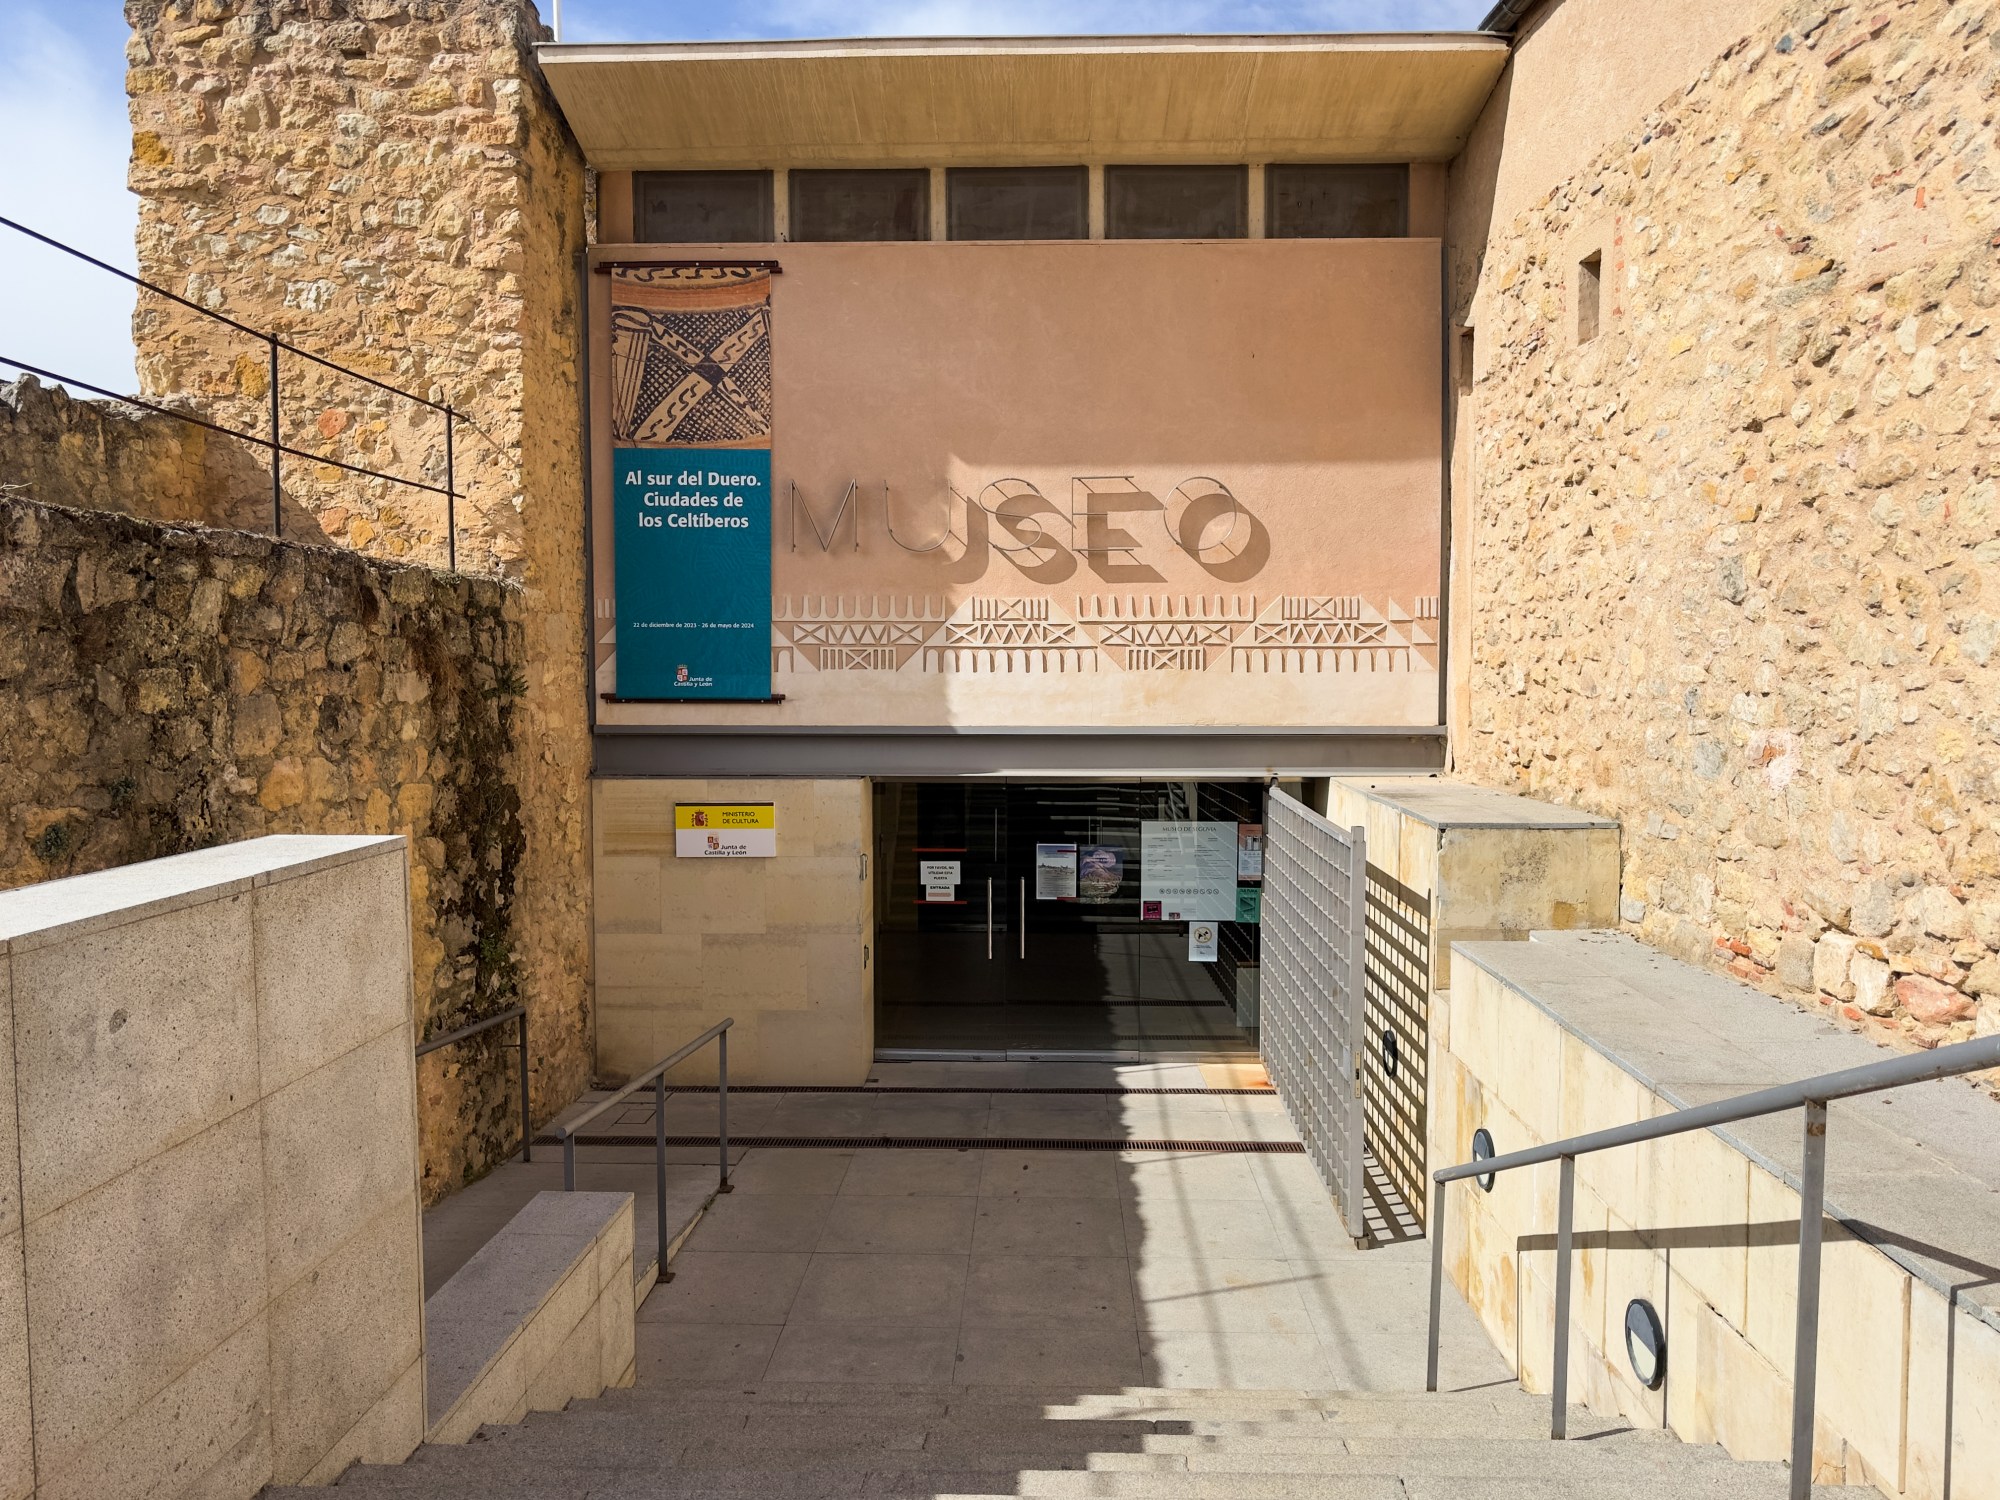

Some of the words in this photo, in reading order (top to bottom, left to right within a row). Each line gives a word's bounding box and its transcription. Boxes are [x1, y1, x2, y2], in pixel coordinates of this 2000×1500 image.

[625, 470, 642, 486] Al
[647, 473, 673, 486] sur
[677, 470, 703, 486] del
[708, 471, 761, 486] Duero.
[643, 491, 719, 507] Ciudades
[723, 491, 743, 507] de
[638, 512, 662, 528] los
[667, 512, 749, 528] Celtíberos
[788, 475, 1238, 553] MUSEO
